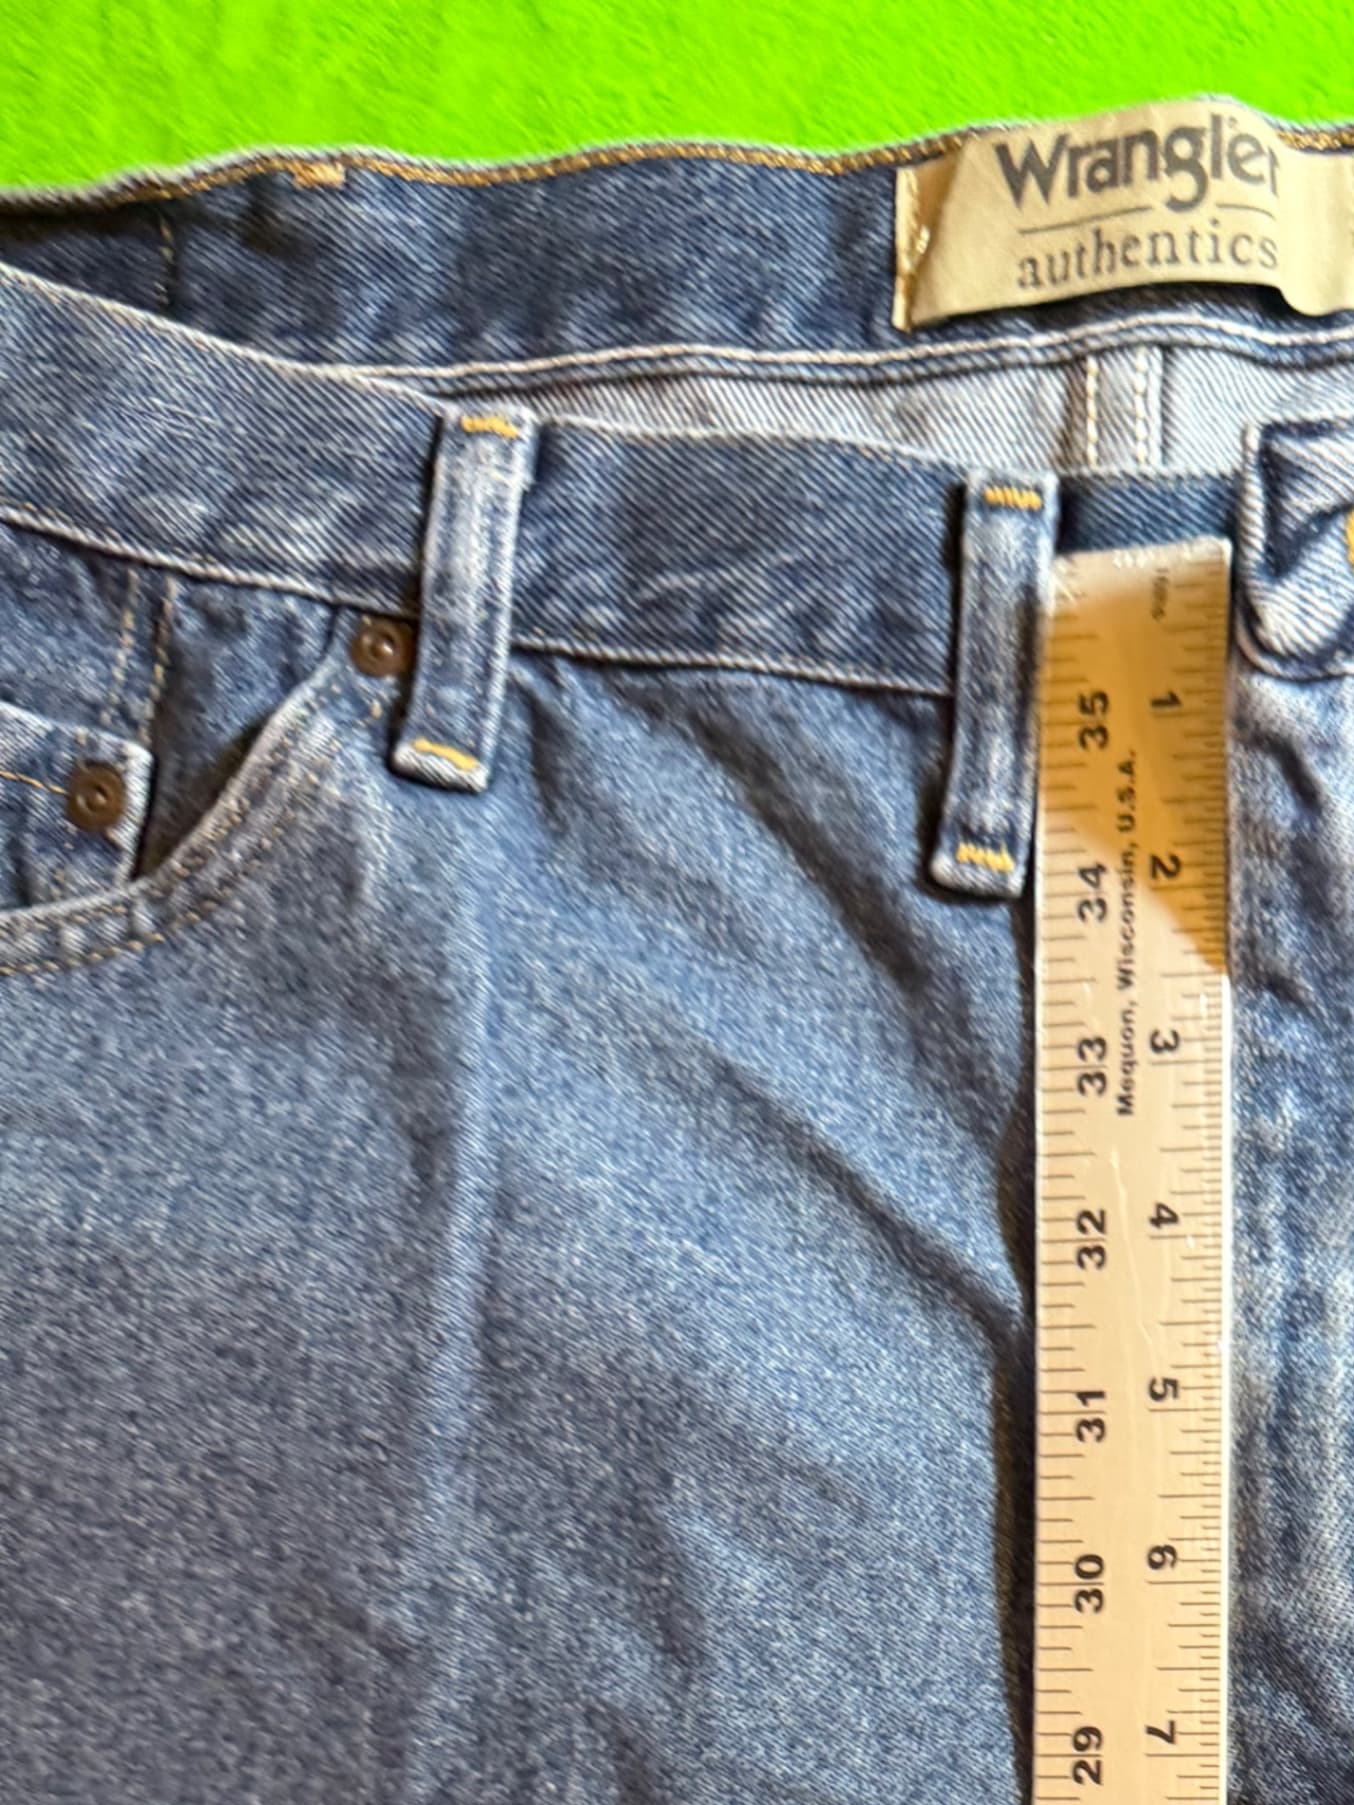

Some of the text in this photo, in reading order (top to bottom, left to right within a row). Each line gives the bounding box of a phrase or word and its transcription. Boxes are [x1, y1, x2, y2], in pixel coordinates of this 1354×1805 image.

[994, 112, 1281, 213] Wrangler
[1016, 219, 1278, 290] authentics
[1078, 691, 1109, 750] 35
[1151, 690, 1182, 708] 1
[1077, 863, 1108, 923] 34
[1150, 854, 1182, 880] 2
[1116, 750, 1139, 1116] Mequon, Wisconsin, U.S.A.
[1076, 1035, 1108, 1096] 33
[1149, 1029, 1181, 1055] 3
[1074, 1208, 1107, 1270] 32
[1148, 1202, 1180, 1230] 4
[1074, 1388, 1107, 1443] 31
[1147, 1377, 1180, 1403] 5
[1073, 1553, 1105, 1614] 30
[1146, 1544, 1179, 1571] 6
[1071, 1725, 1104, 1786] 29
[1145, 1719, 1178, 1745] 7
